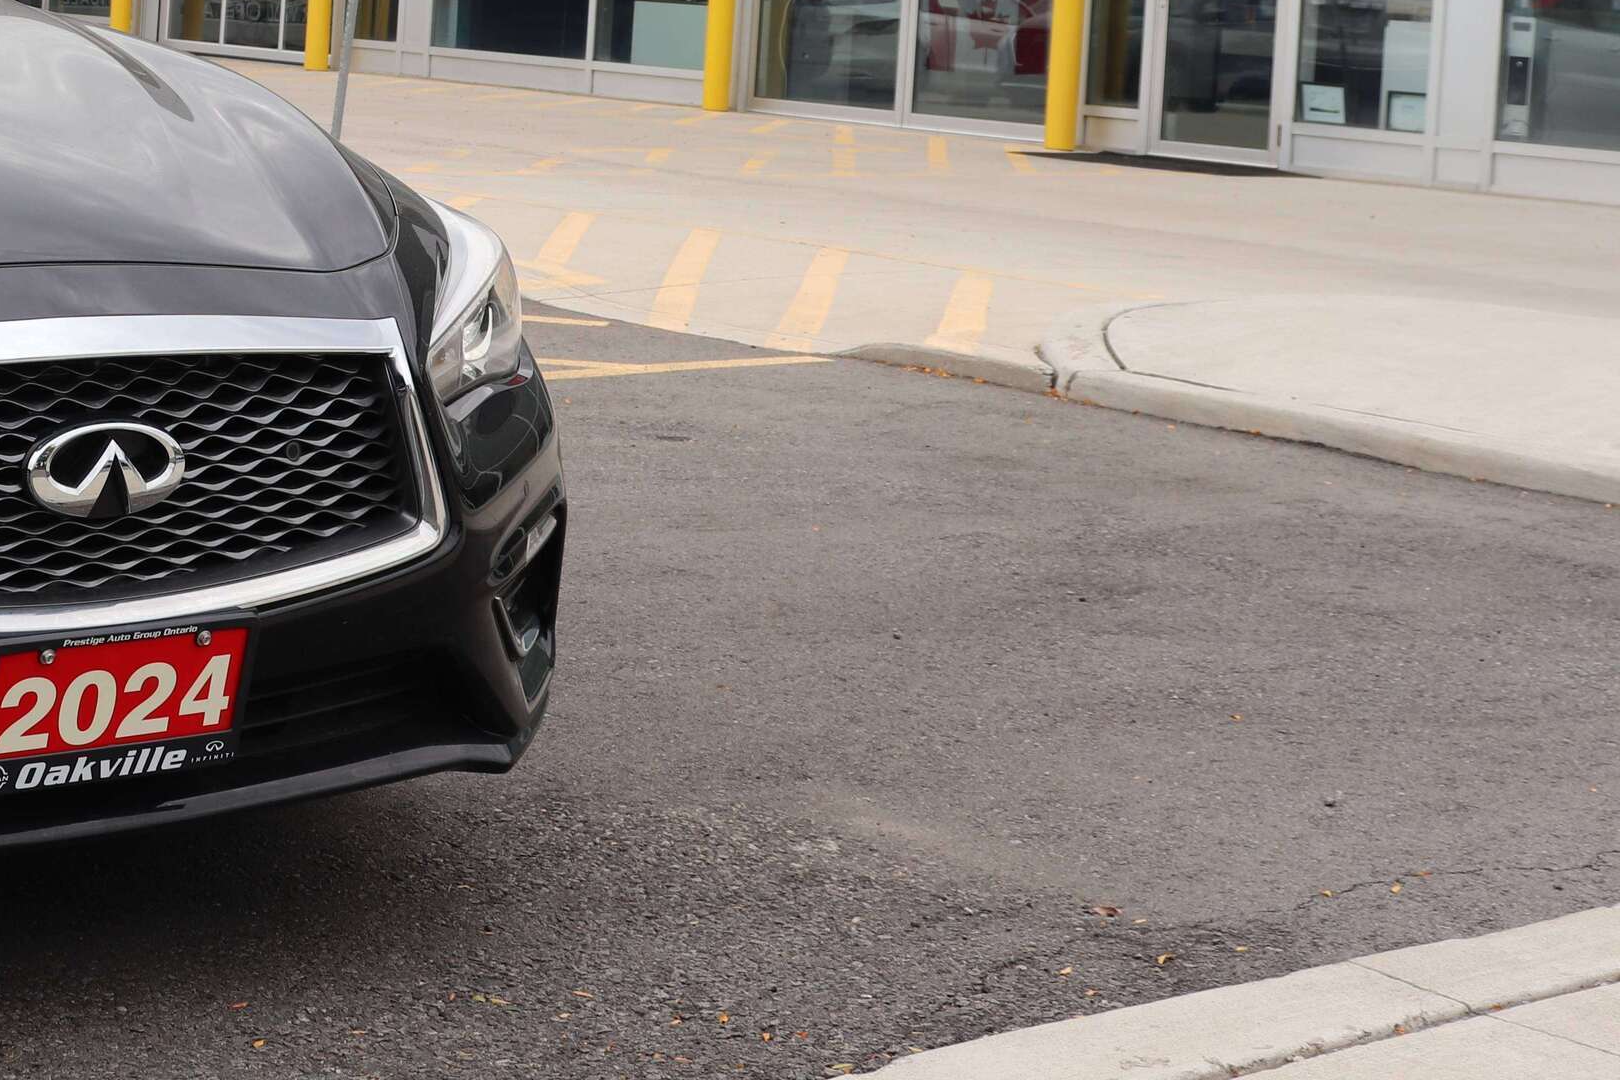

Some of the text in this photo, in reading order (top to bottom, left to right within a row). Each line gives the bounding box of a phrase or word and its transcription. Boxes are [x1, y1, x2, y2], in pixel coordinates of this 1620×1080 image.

[62, 625, 199, 648] Prestige Auto Group Ontario
[14, 745, 187, 791] Oakville
[191, 751, 235, 764] INFINITI
